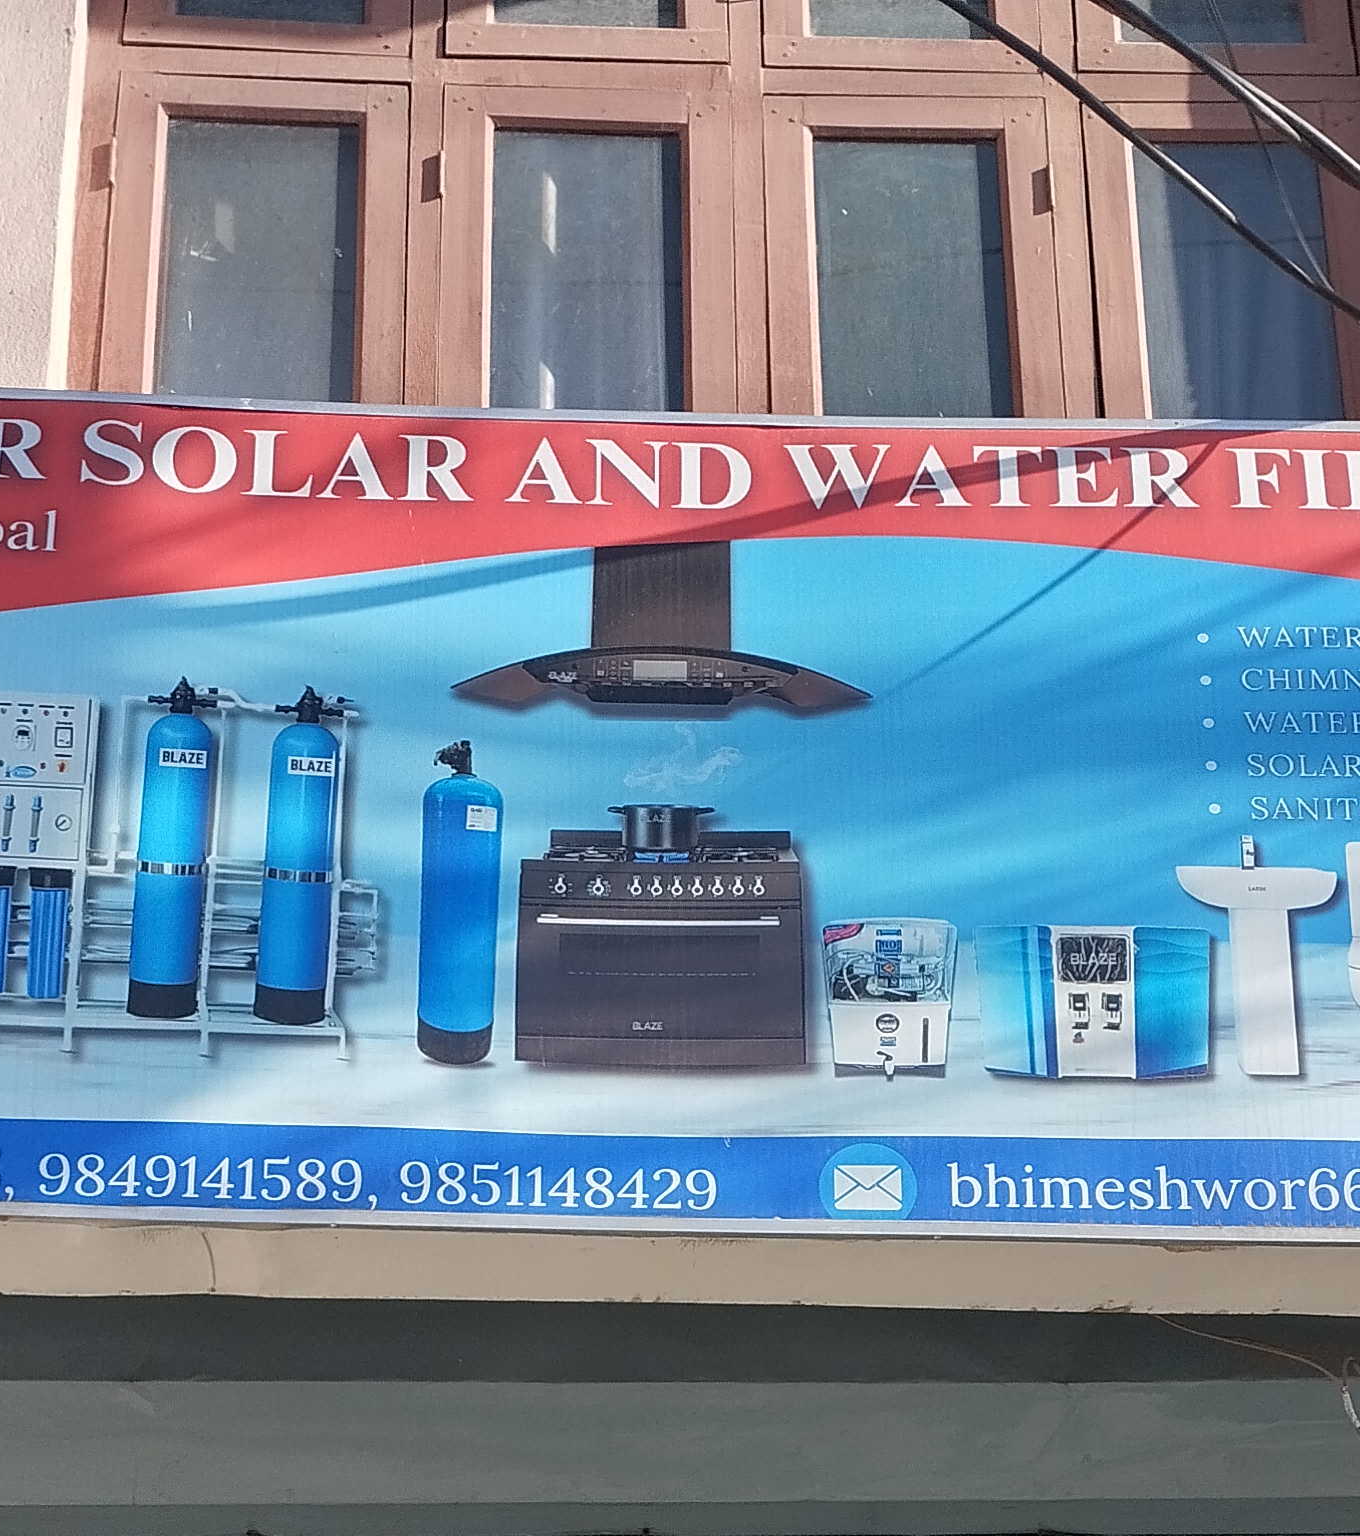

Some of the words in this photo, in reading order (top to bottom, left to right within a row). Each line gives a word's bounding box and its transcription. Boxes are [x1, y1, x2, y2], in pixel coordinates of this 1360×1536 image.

[79, 418, 473, 502] SOLAR
[506, 435, 751, 509] AND
[783, 443, 1199, 510] WATER
[162, 750, 205, 766] BLAZE
[290, 758, 333, 775] BLAZE
[1071, 952, 1117, 965] BLAZE
[632, 1021, 663, 1031] BLAZE
[39, 1153, 379, 1212] 9849141589,
[400, 1160, 718, 1213] 9851148429
